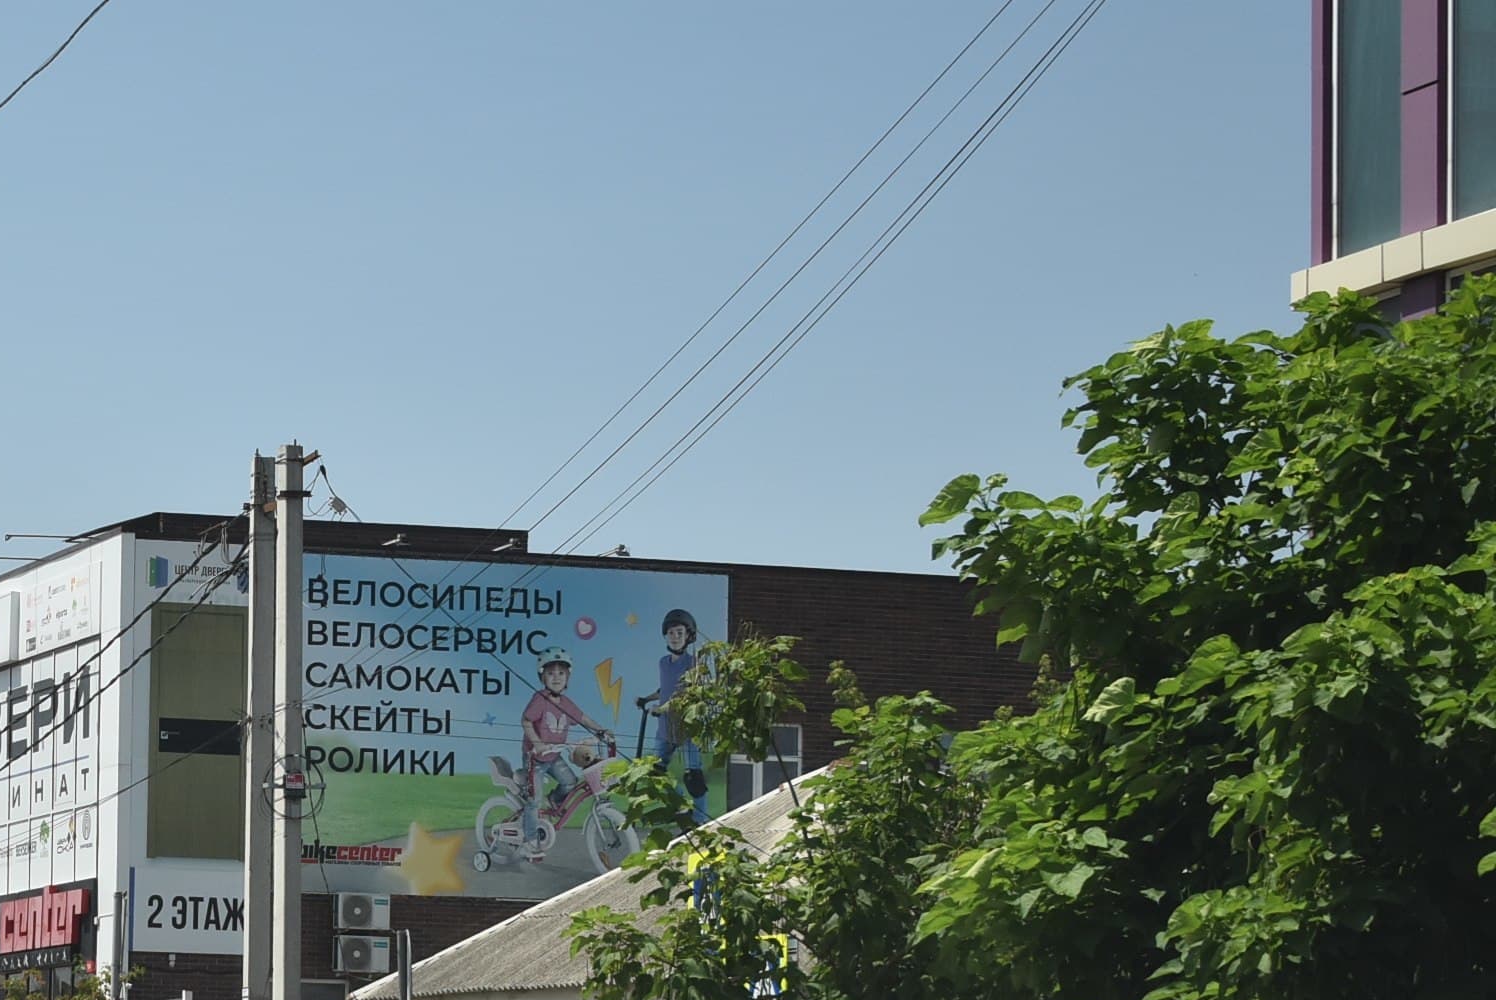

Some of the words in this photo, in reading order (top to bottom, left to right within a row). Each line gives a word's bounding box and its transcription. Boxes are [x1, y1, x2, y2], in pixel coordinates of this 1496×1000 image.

[307, 577, 562, 618] ВЕЛОСИПЕДЫ
[307, 619, 548, 655] ВЕЛОСЕРВИС
[305, 662, 510, 695] САМОКАТЫ
[305, 700, 451, 735] СКЕЙТЫ
[305, 745, 455, 776] РОЛИКИ
[147, 894, 164, 928] 2
[171, 895, 245, 932] ЭТАЖ
